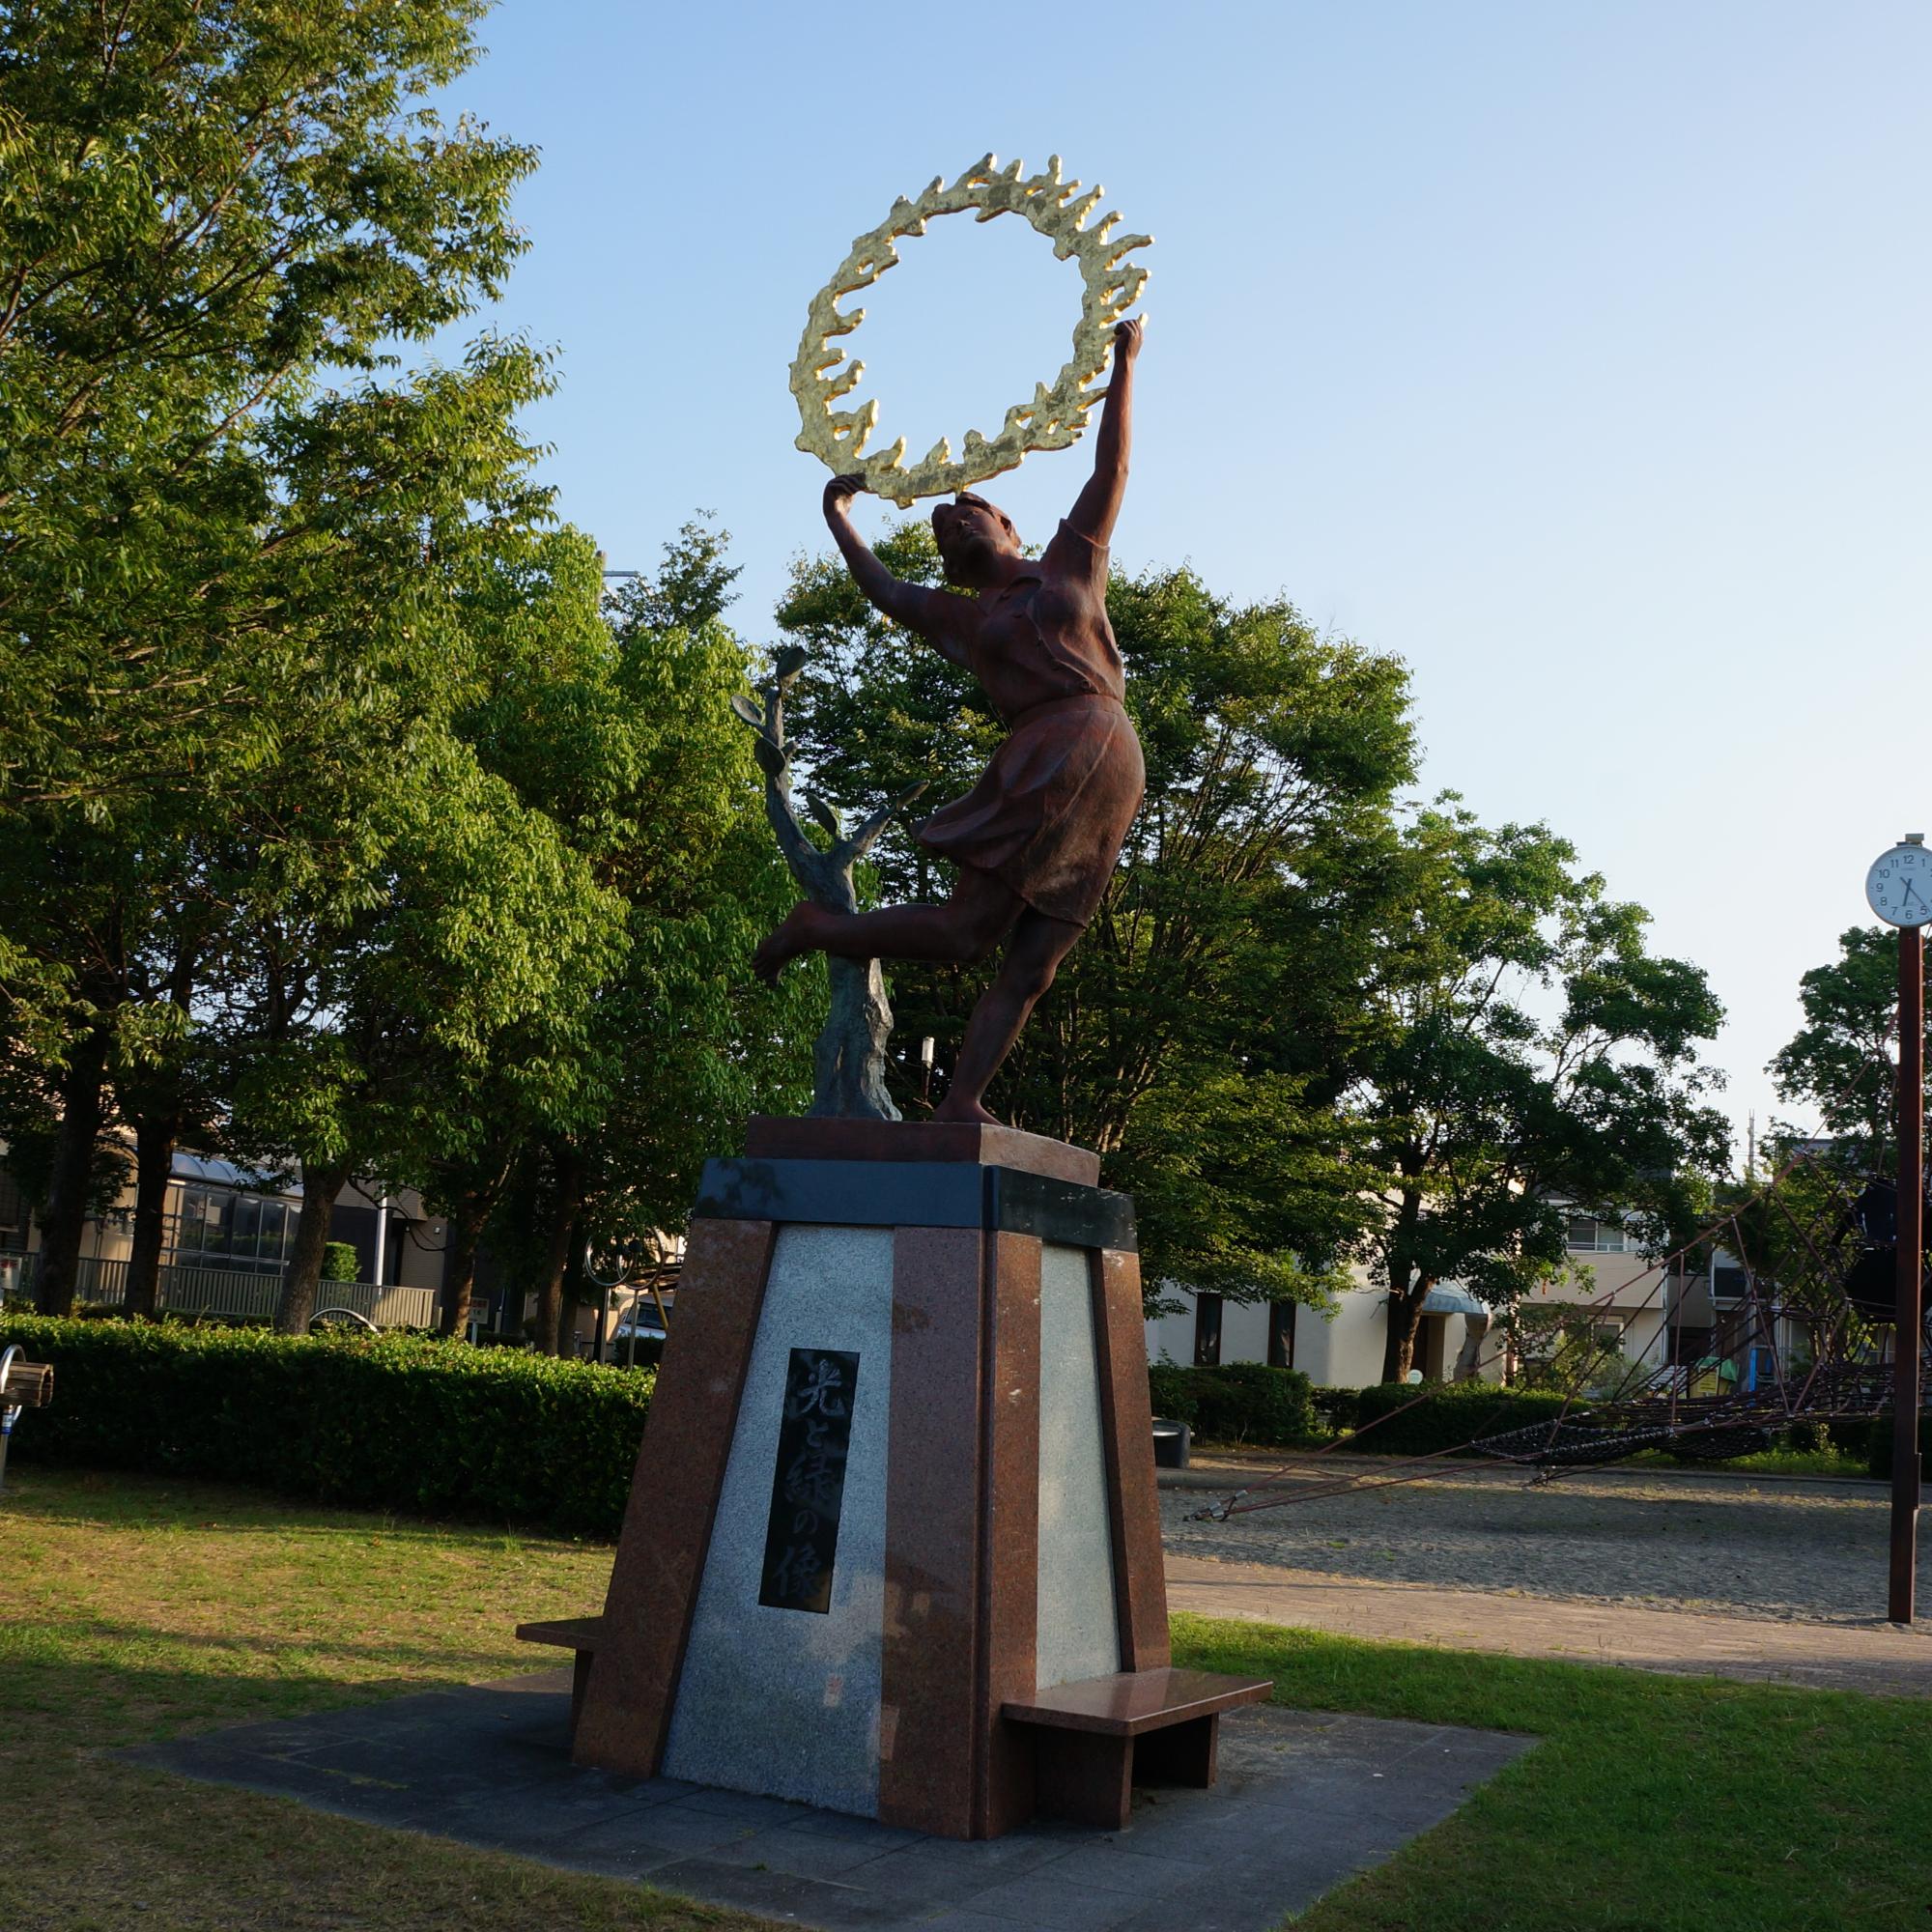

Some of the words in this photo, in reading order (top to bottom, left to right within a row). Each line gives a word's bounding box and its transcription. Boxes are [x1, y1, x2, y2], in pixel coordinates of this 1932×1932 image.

[1890, 859, 1899, 867] 11
[1903, 855, 1915, 864] 12
[1921, 858, 1925, 867] 1
[1879, 868, 1890, 878] 10
[1876, 883, 1884, 892] 9
[1880, 896, 1888, 906] 8
[1891, 906, 1898, 916] 7
[1905, 910, 1913, 920] 6
[1919, 906, 1927, 915] 5
